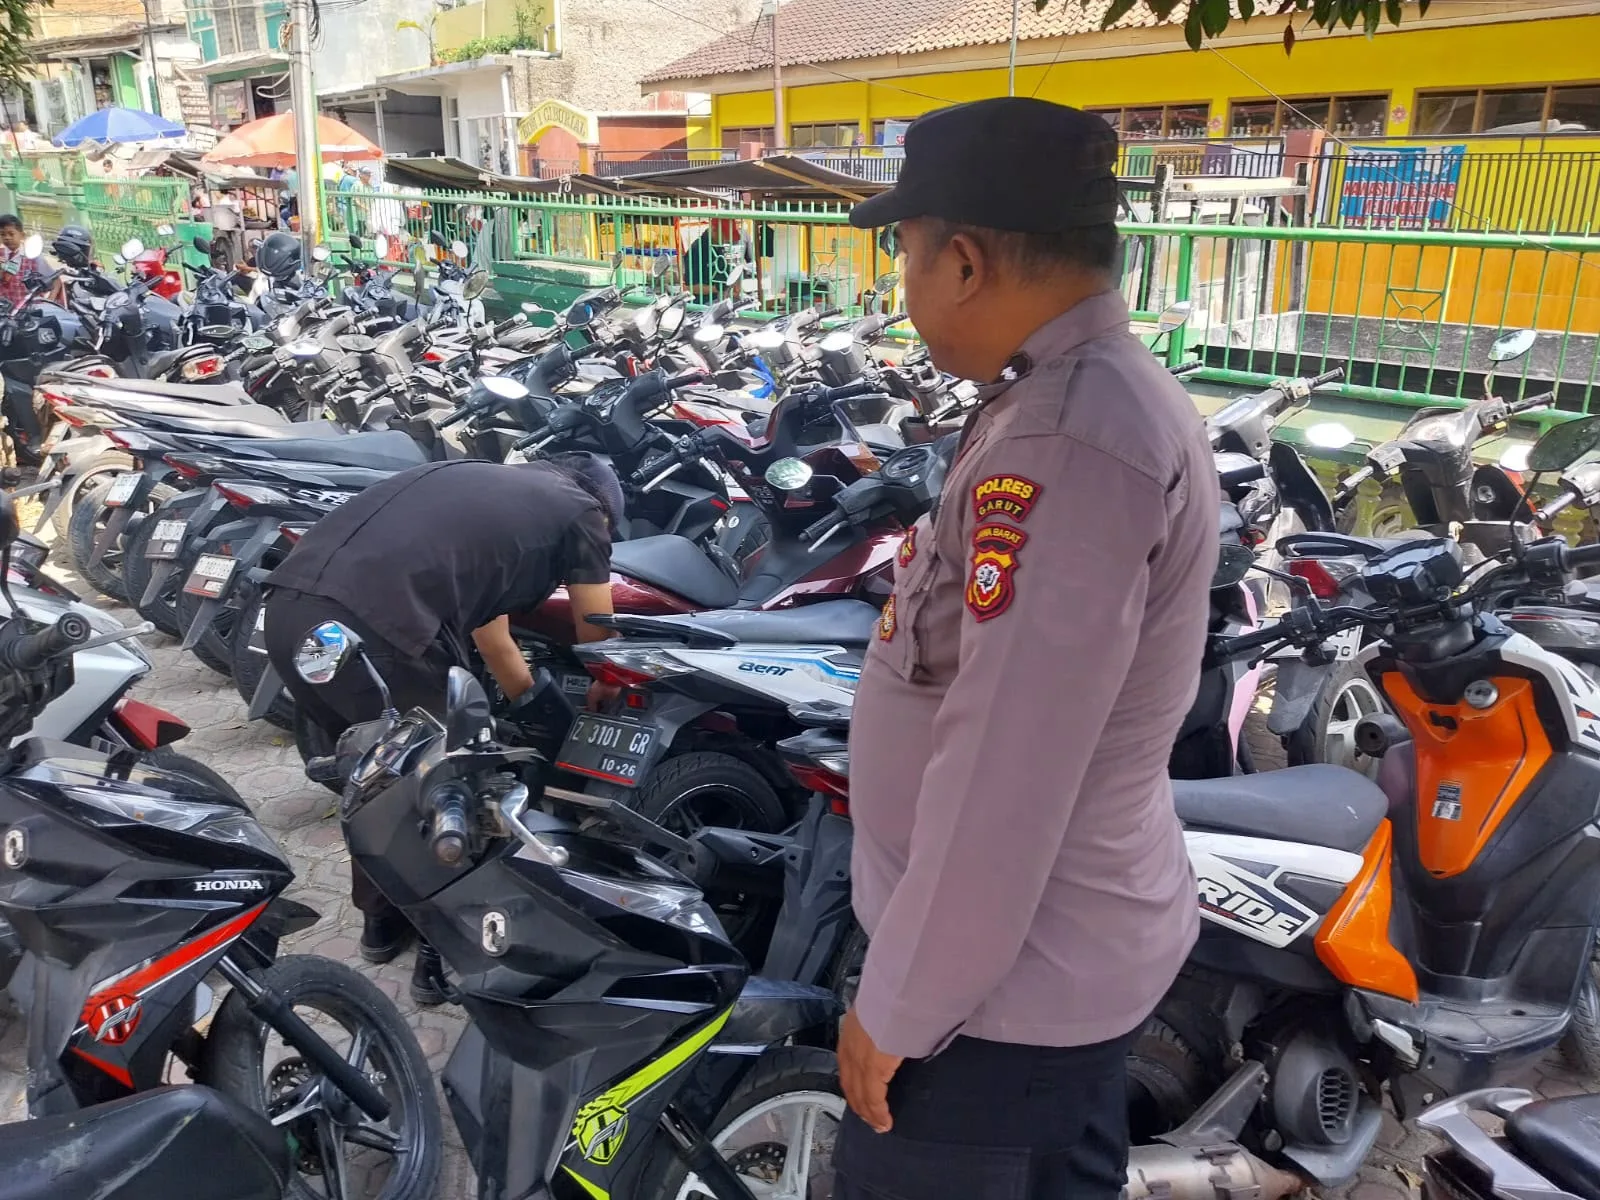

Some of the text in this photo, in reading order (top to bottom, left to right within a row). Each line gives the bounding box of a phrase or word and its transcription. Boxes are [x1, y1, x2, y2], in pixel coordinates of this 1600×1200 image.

[975, 478, 1034, 501] POLRES
[978, 499, 1022, 515] GARUT
[993, 527, 1021, 544] BARAT
[572, 721, 650, 755] Z 3101 GR
[194, 879, 264, 892] HONDA
